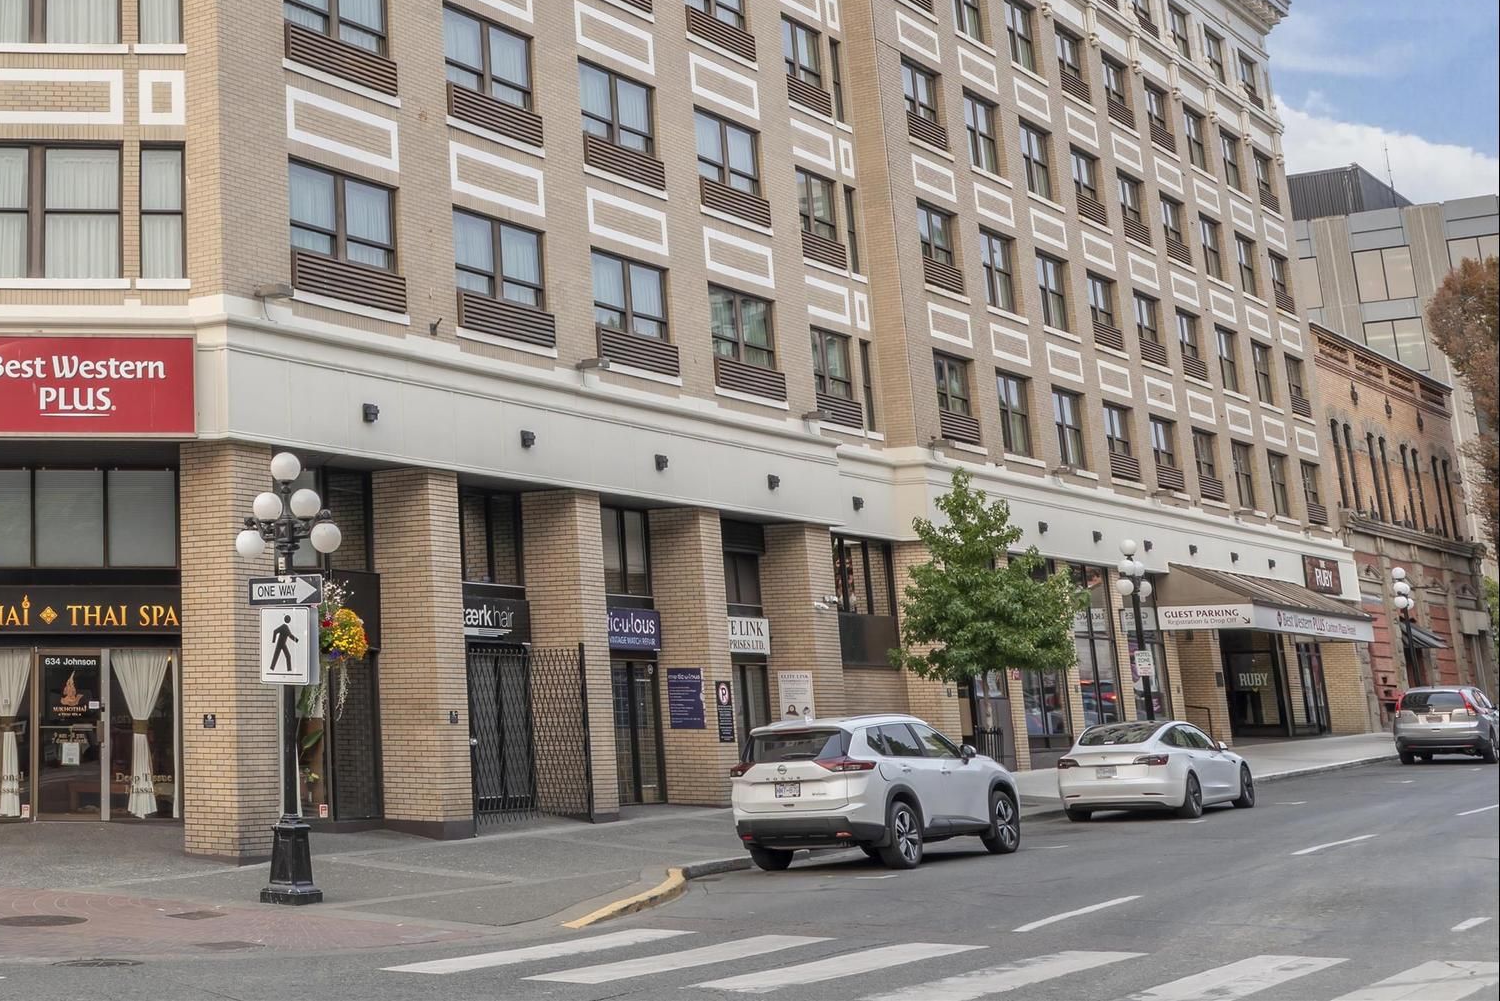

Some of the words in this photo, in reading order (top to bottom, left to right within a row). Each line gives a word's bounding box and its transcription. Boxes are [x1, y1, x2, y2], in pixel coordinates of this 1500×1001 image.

[53, 355, 166, 379] Western
[1315, 568, 1333, 587] RUBY
[258, 586, 275, 597] ONE
[279, 585, 296, 597] WAY
[67, 605, 128, 626] THAI
[139, 605, 180, 626] SPA
[1164, 610, 1193, 618] GUEST
[1196, 609, 1239, 617] PARKING
[740, 620, 764, 636] LINK
[730, 639, 750, 649] PRISES
[45, 658, 60, 666] 634
[63, 658, 96, 666] Johnson
[1238, 673, 1268, 686] RUBY
[115, 772, 140, 783] Deep
[142, 772, 173, 782] Tissue
